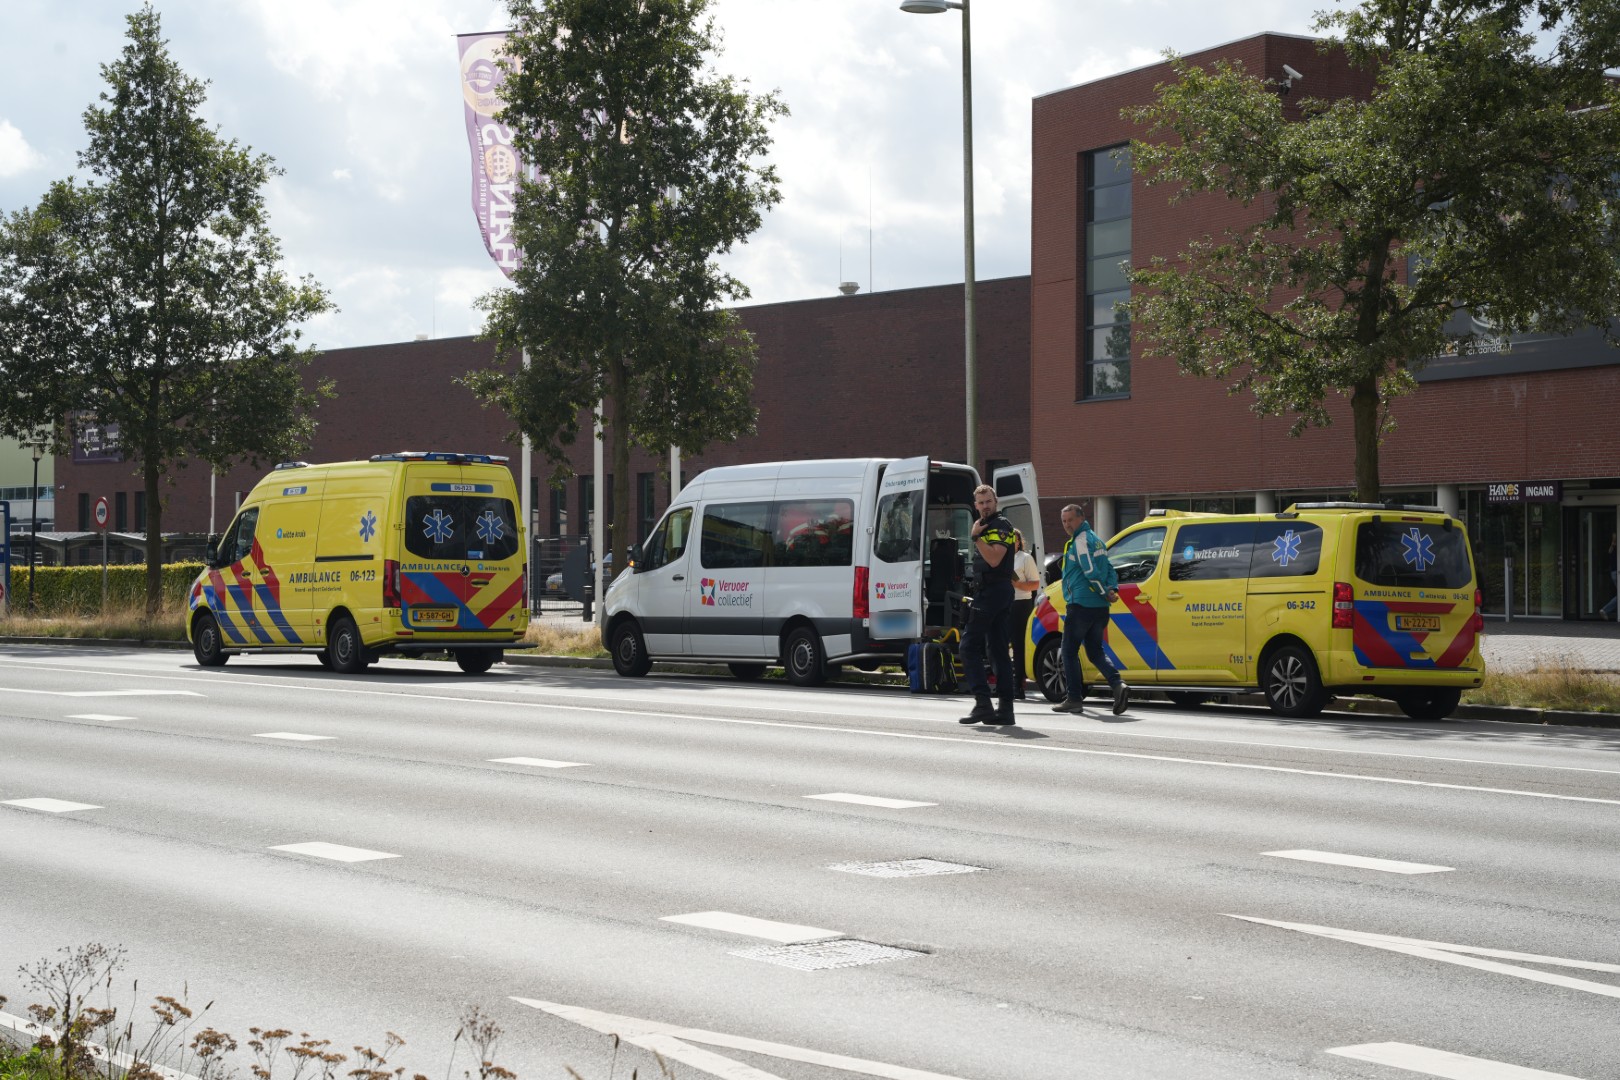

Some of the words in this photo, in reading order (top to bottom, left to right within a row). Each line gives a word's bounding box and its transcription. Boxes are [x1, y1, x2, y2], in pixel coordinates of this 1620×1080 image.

[1489, 484, 1519, 496] HANOS
[1526, 486, 1554, 496] INGANG
[295, 530, 306, 538] kruis
[1195, 549, 1217, 559] witte
[1219, 547, 1240, 558] kruis
[289, 571, 341, 583] AMBULANCE
[350, 570, 376, 581] 06-123
[719, 580, 749, 592] Vervoer
[887, 590, 911, 598] collectief
[718, 594, 753, 608] collectief
[1185, 602, 1243, 612] AMBULANCE
[1287, 601, 1315, 609] 06-342
[1404, 618, 1437, 628] N-222-TJ
[1233, 655, 1244, 664] 112
